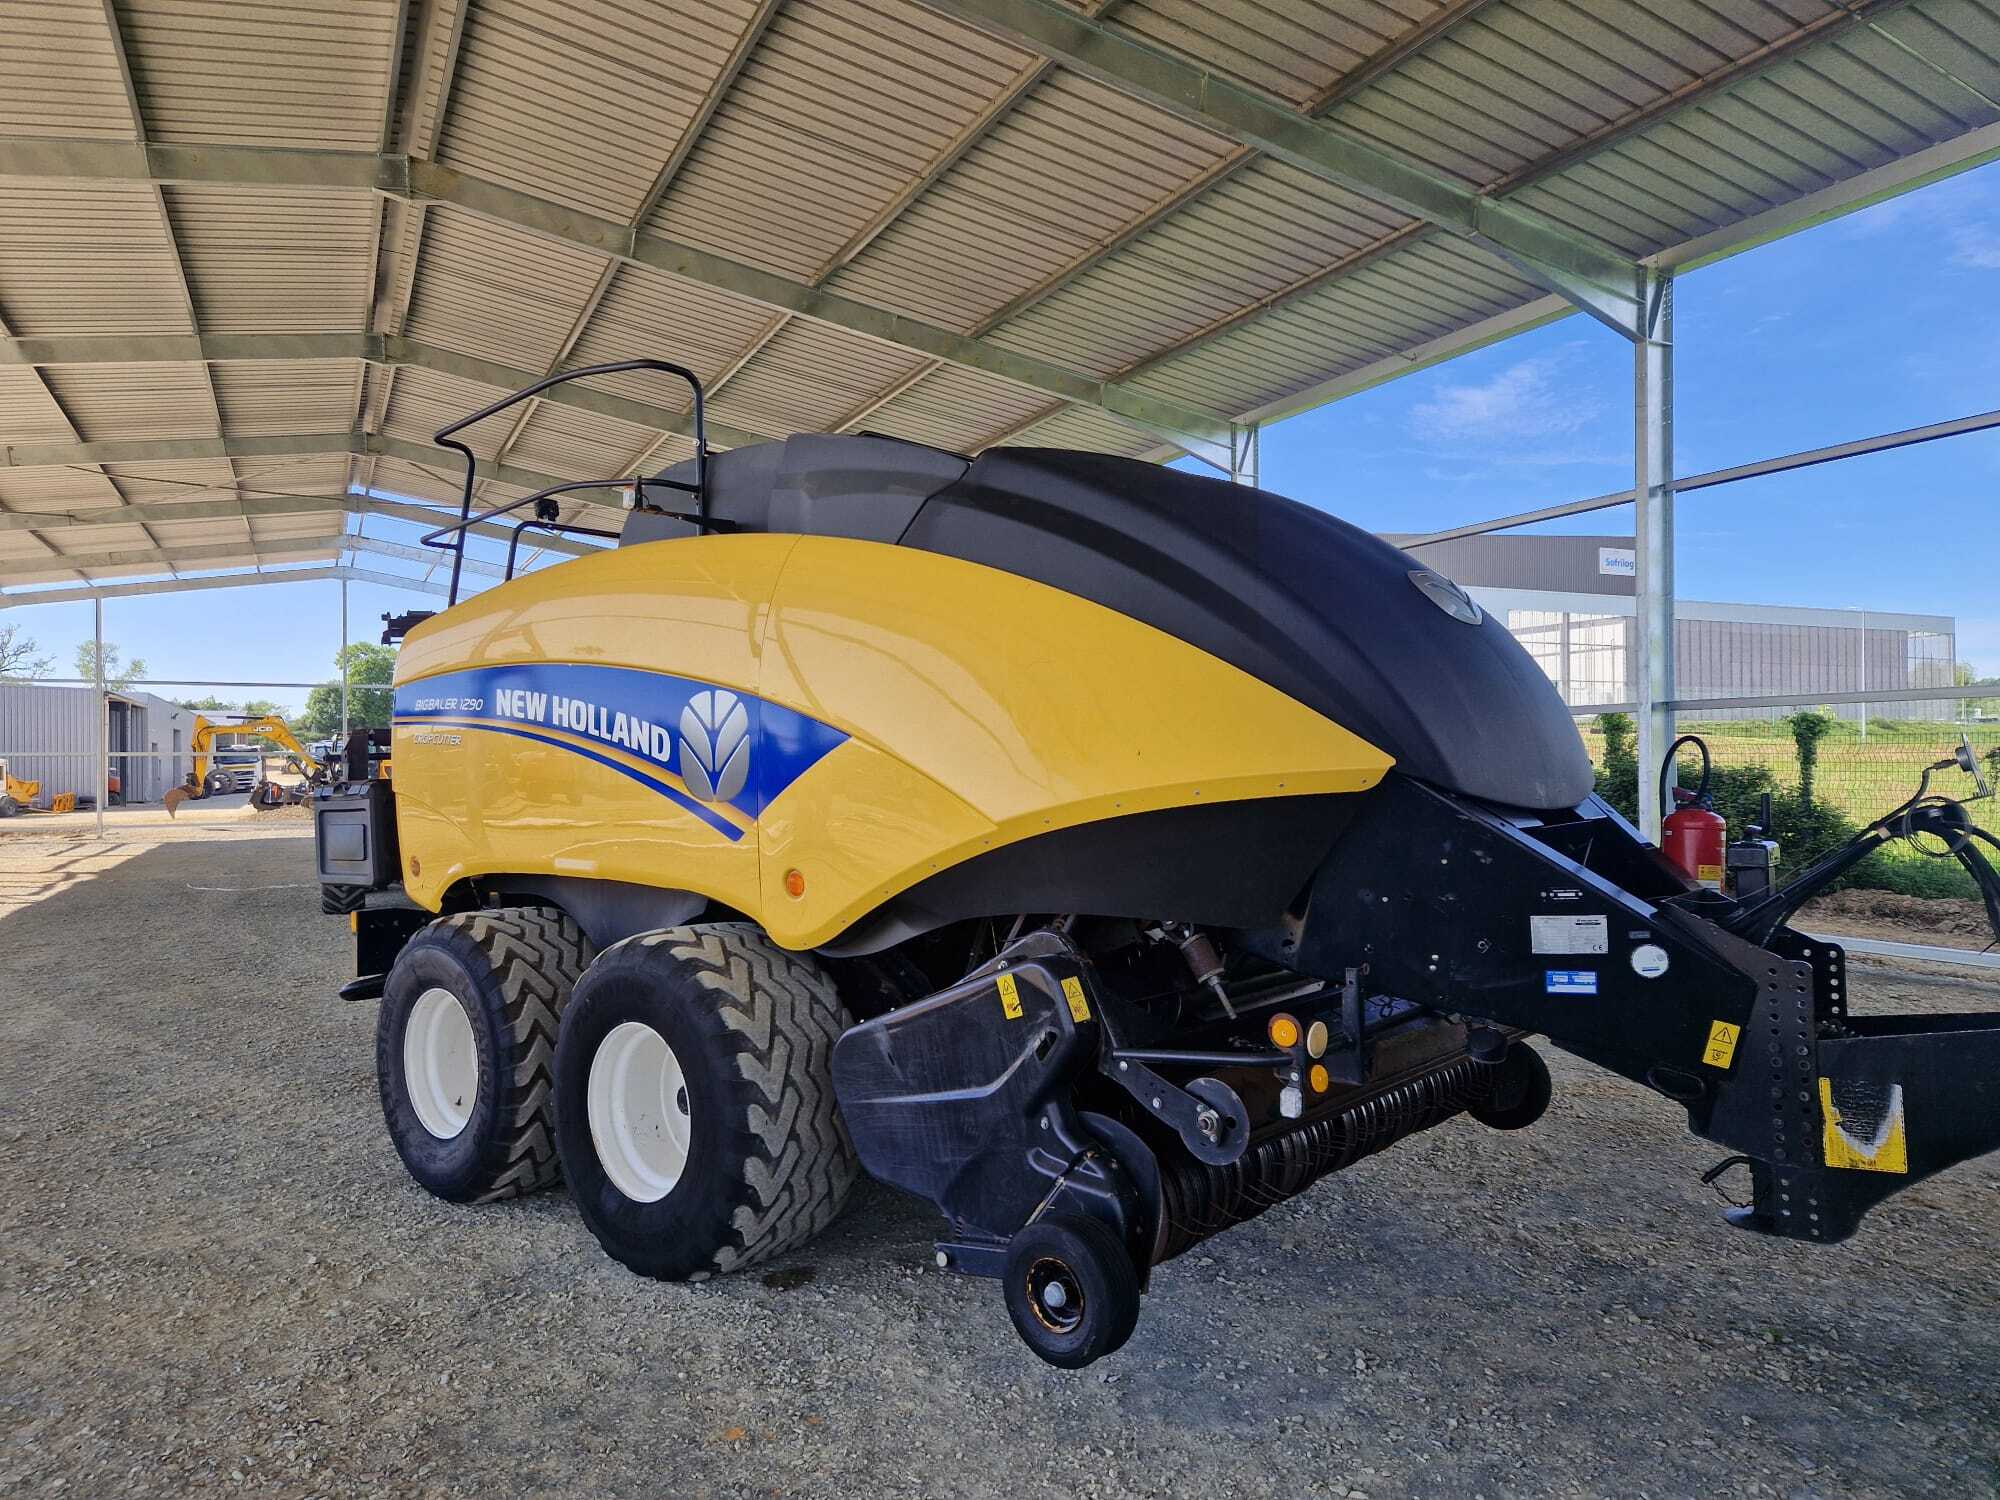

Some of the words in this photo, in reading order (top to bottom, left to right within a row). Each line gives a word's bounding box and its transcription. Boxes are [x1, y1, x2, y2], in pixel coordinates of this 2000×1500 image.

[414, 698, 457, 711] BIGBALER
[459, 698, 484, 711] 1290
[496, 688, 547, 723] NEW
[552, 696, 671, 763] HOLLAND
